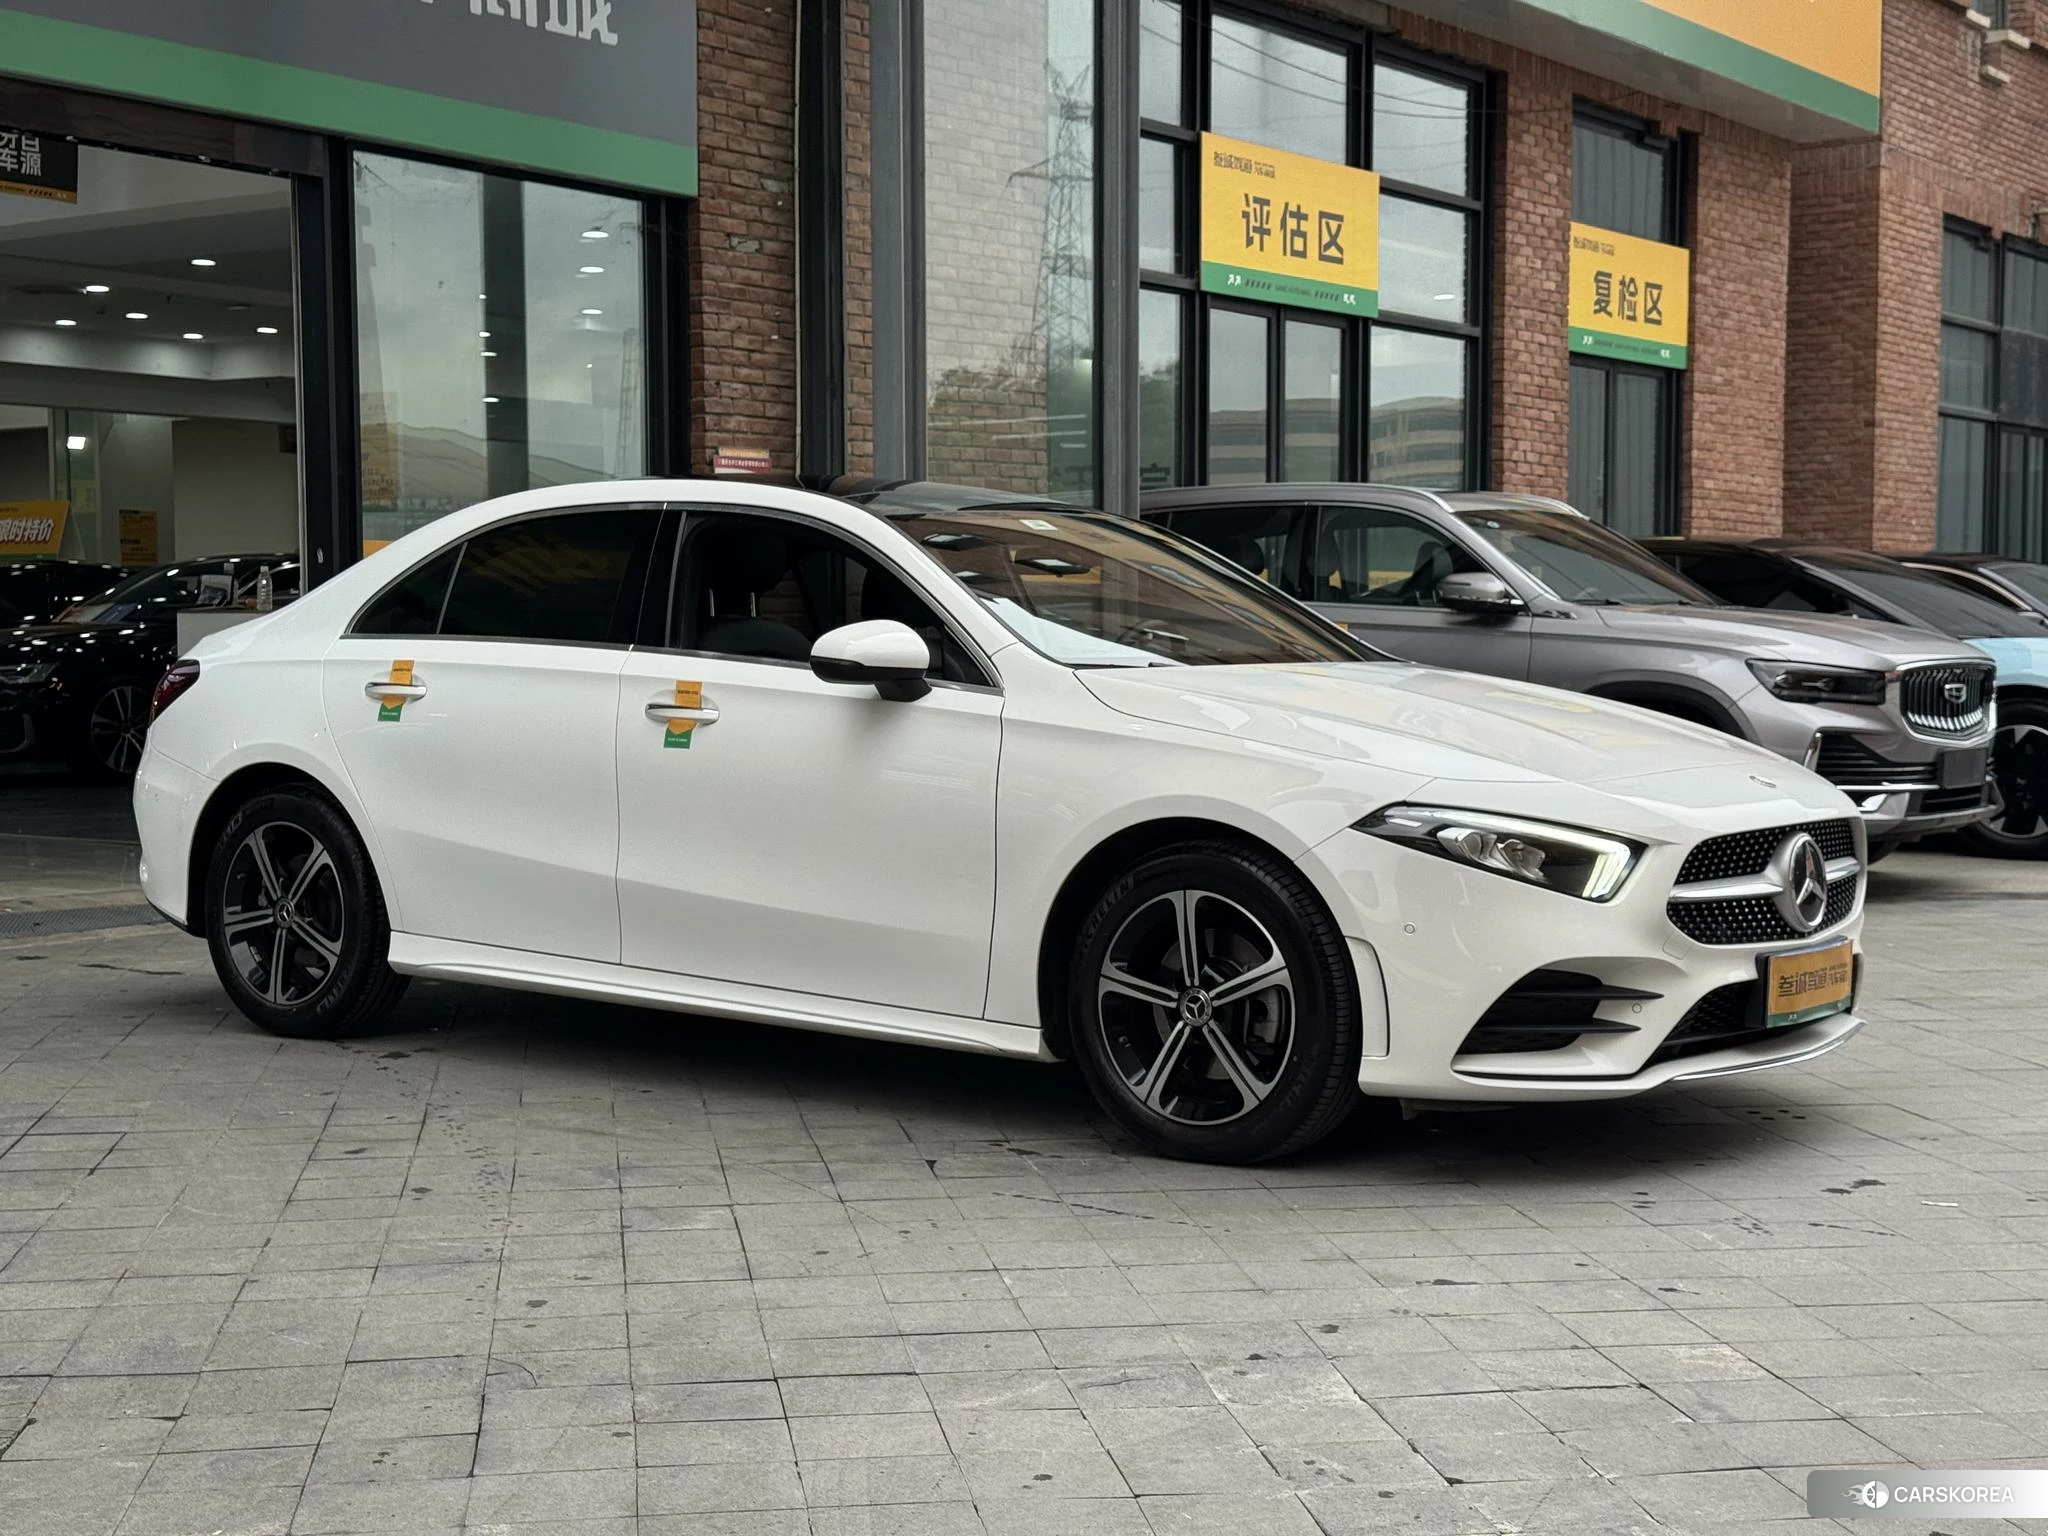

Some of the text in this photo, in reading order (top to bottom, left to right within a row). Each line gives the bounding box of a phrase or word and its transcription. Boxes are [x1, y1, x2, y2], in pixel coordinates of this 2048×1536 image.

[1242, 193, 1344, 265] 评估区
[1593, 270, 1663, 326] 复检区
